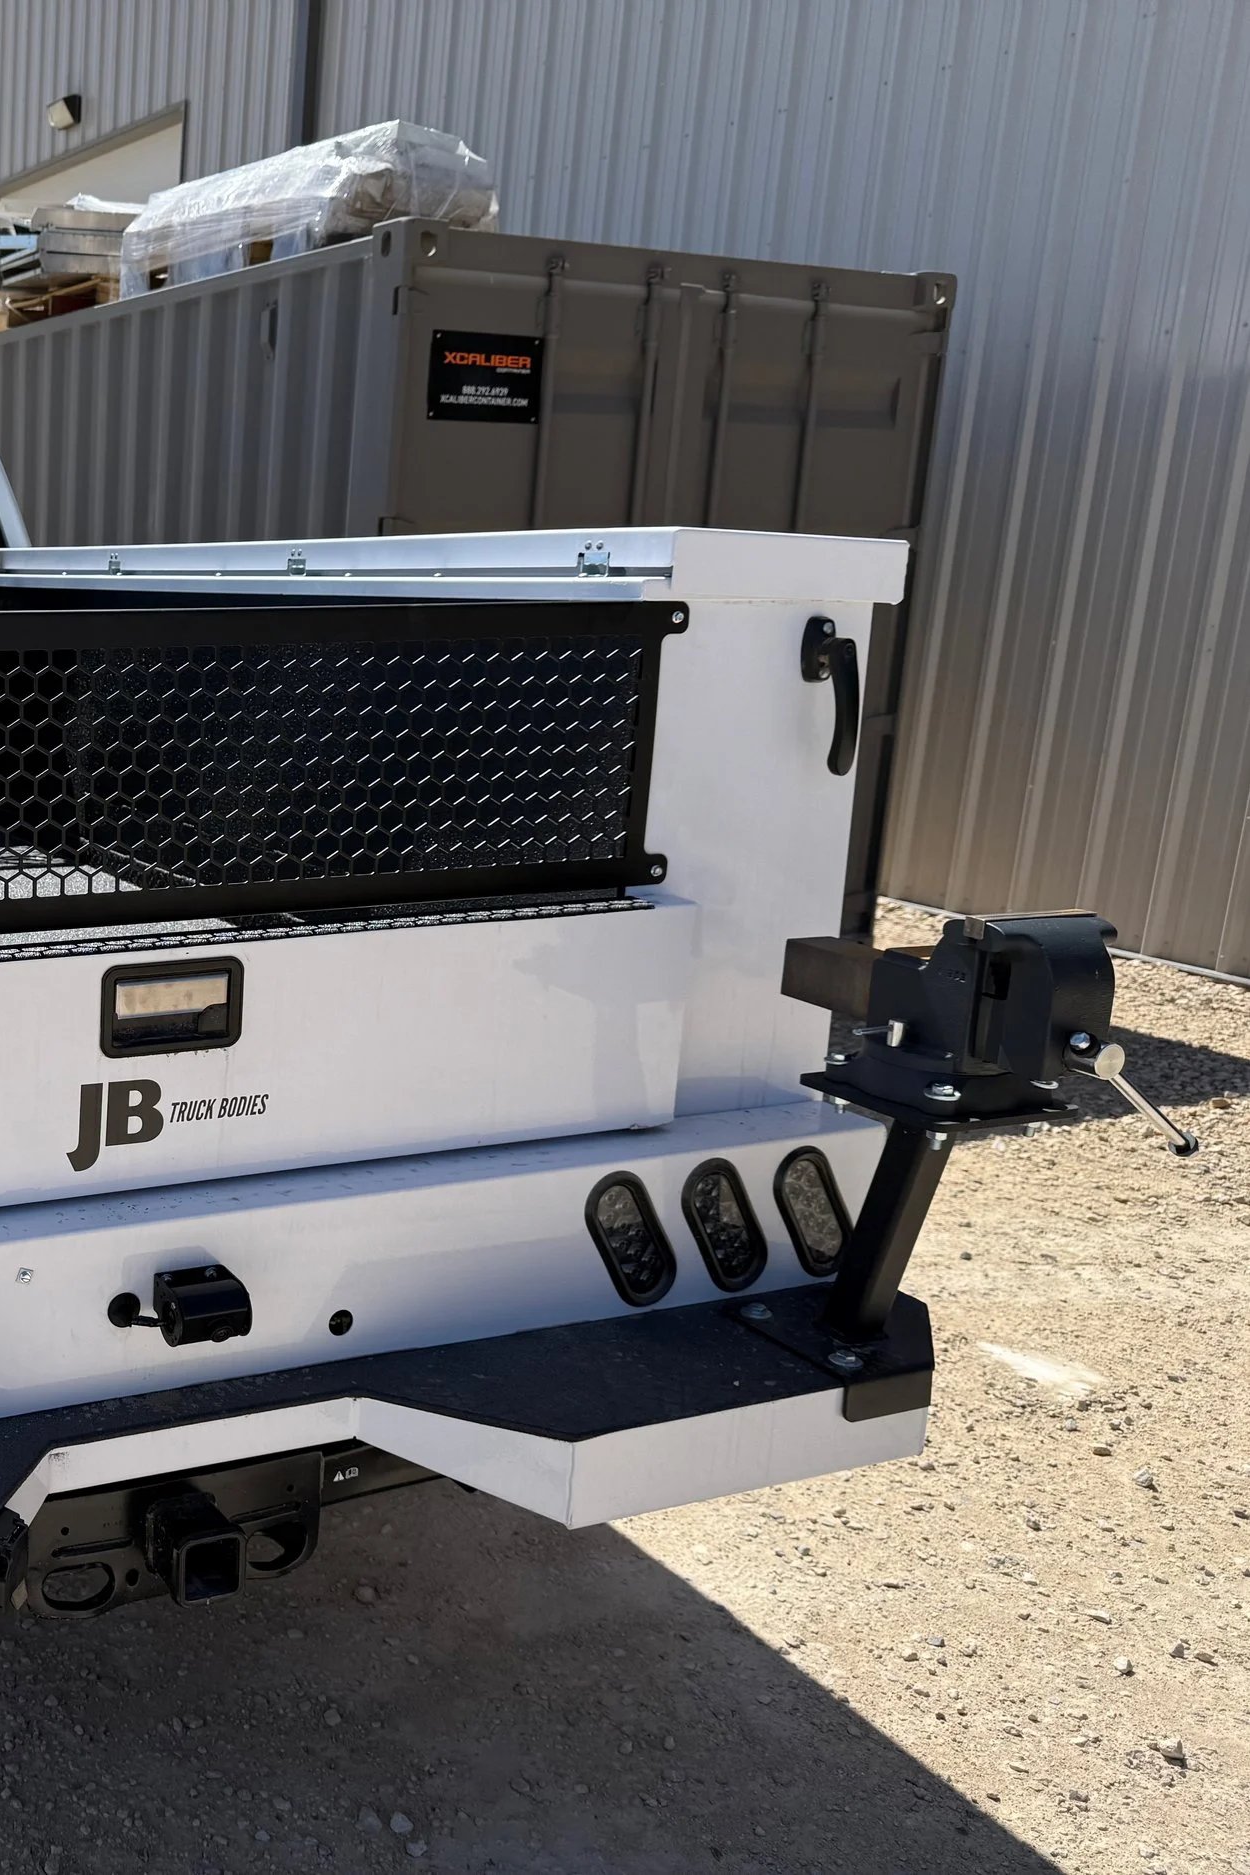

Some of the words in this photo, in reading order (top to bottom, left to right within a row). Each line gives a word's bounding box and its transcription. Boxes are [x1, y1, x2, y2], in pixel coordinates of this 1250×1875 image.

[444, 352, 531, 368] XCALIBER
[66, 1079, 164, 1172] JB
[170, 1099, 217, 1123] TRUCK
[218, 1094, 269, 1119] BODIES
